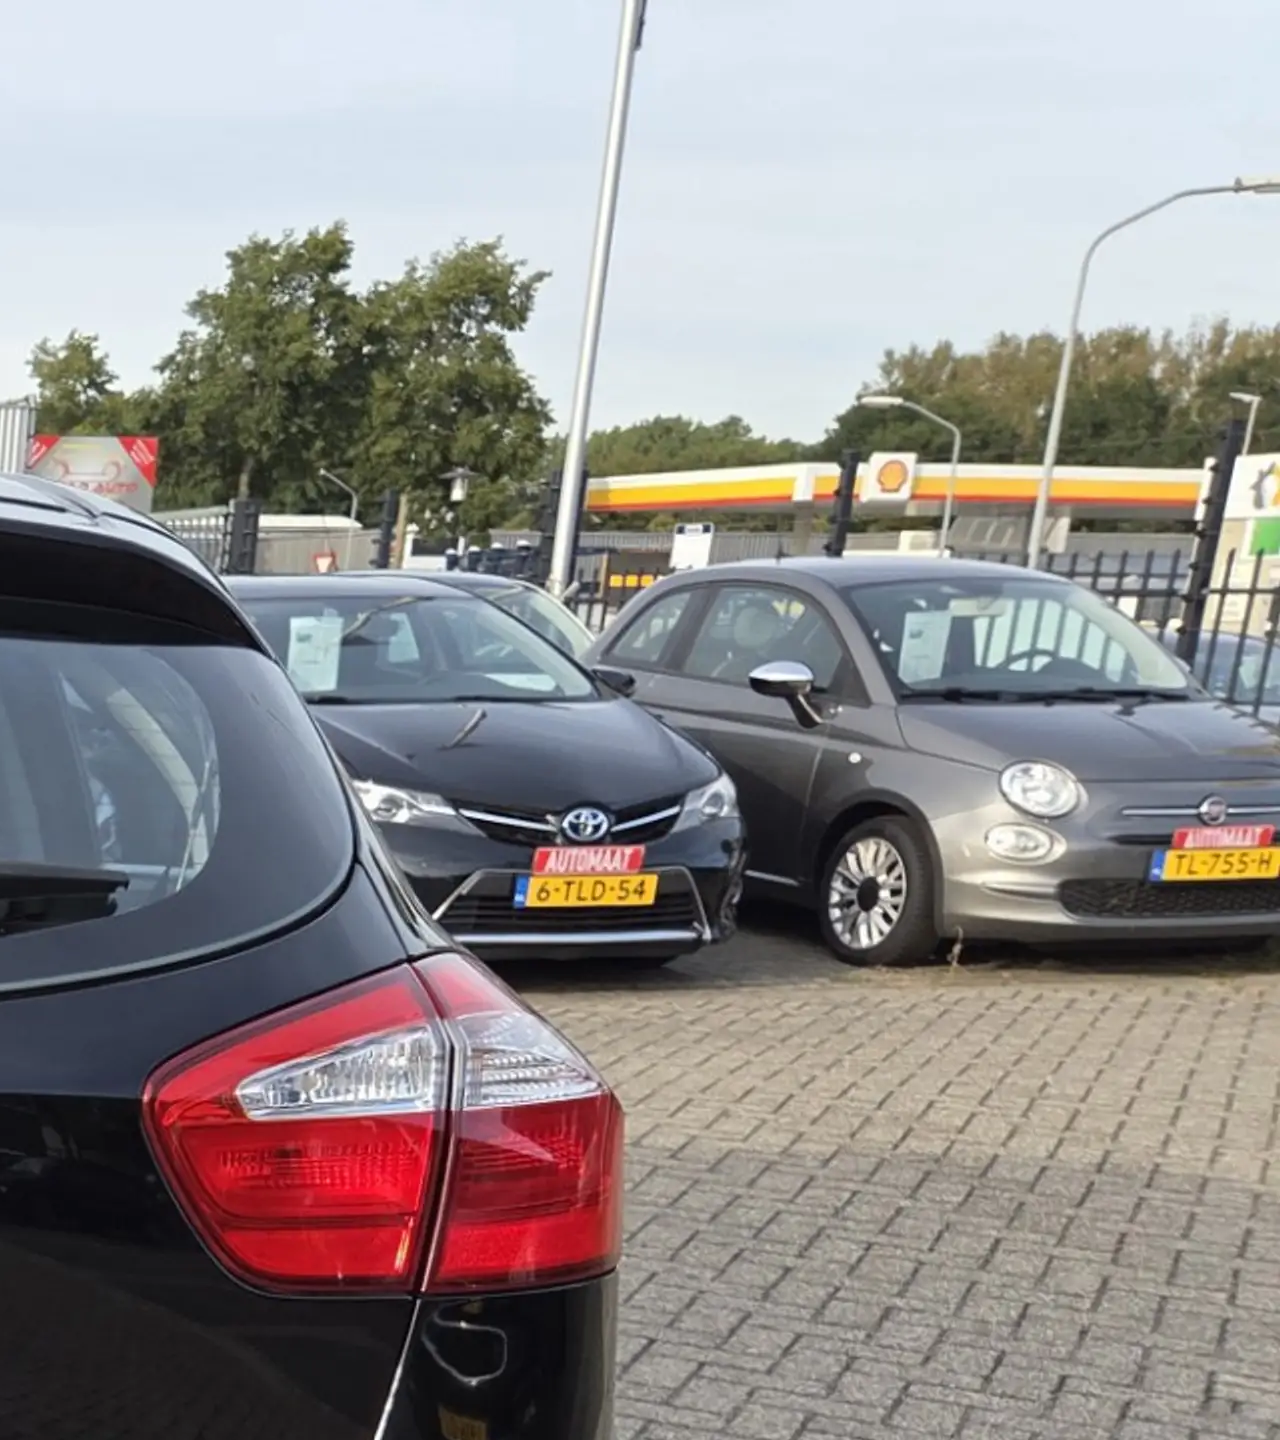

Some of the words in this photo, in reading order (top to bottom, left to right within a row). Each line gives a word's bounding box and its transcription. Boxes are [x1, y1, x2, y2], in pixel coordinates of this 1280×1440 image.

[543, 848, 636, 873] AUTOMAAT
[1176, 850, 1274, 876] TL-755-H
[536, 878, 646, 902] 6-TLD-54
